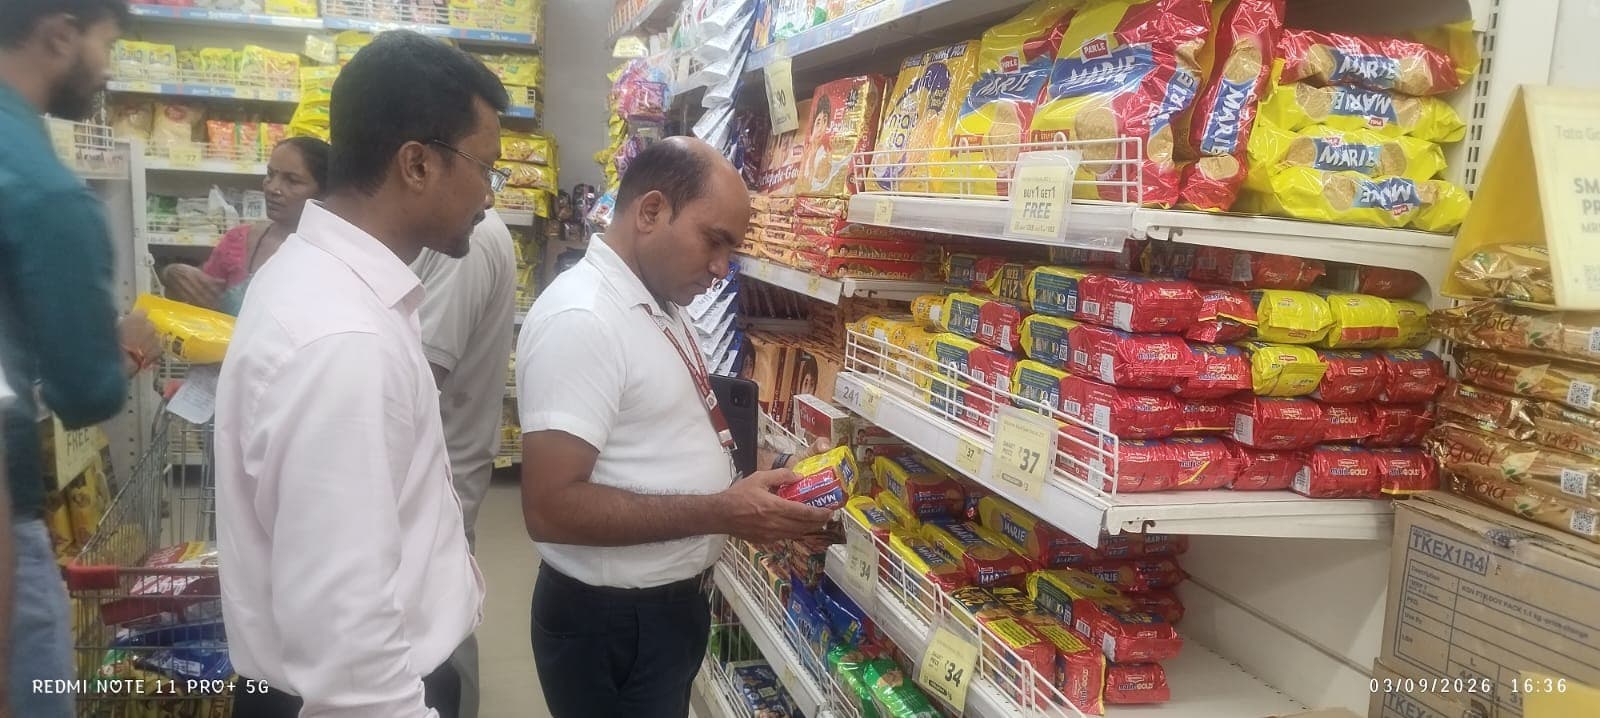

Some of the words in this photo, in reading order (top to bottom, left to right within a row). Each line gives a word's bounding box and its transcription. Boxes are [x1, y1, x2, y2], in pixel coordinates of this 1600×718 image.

[1083, 42, 1106, 54] PARLE
[1339, 55, 1399, 79] MARIE
[975, 71, 1038, 97] MARIE
[1333, 92, 1393, 115] MARIE
[1208, 85, 1245, 154] MARIE
[1555, 125, 1583, 140] Tata
[1319, 146, 1378, 168] MARIE
[1023, 188, 1034, 198] BUY
[1040, 189, 1051, 198] GET
[1574, 178, 1600, 195] SM
[1023, 202, 1052, 219] FREE
[1583, 200, 1600, 215] PR
[1466, 359, 1511, 381] gold
[1449, 442, 1495, 467] gold
[1004, 520, 1026, 542] MARIE
[1412, 532, 1485, 573] TKEX1R4
